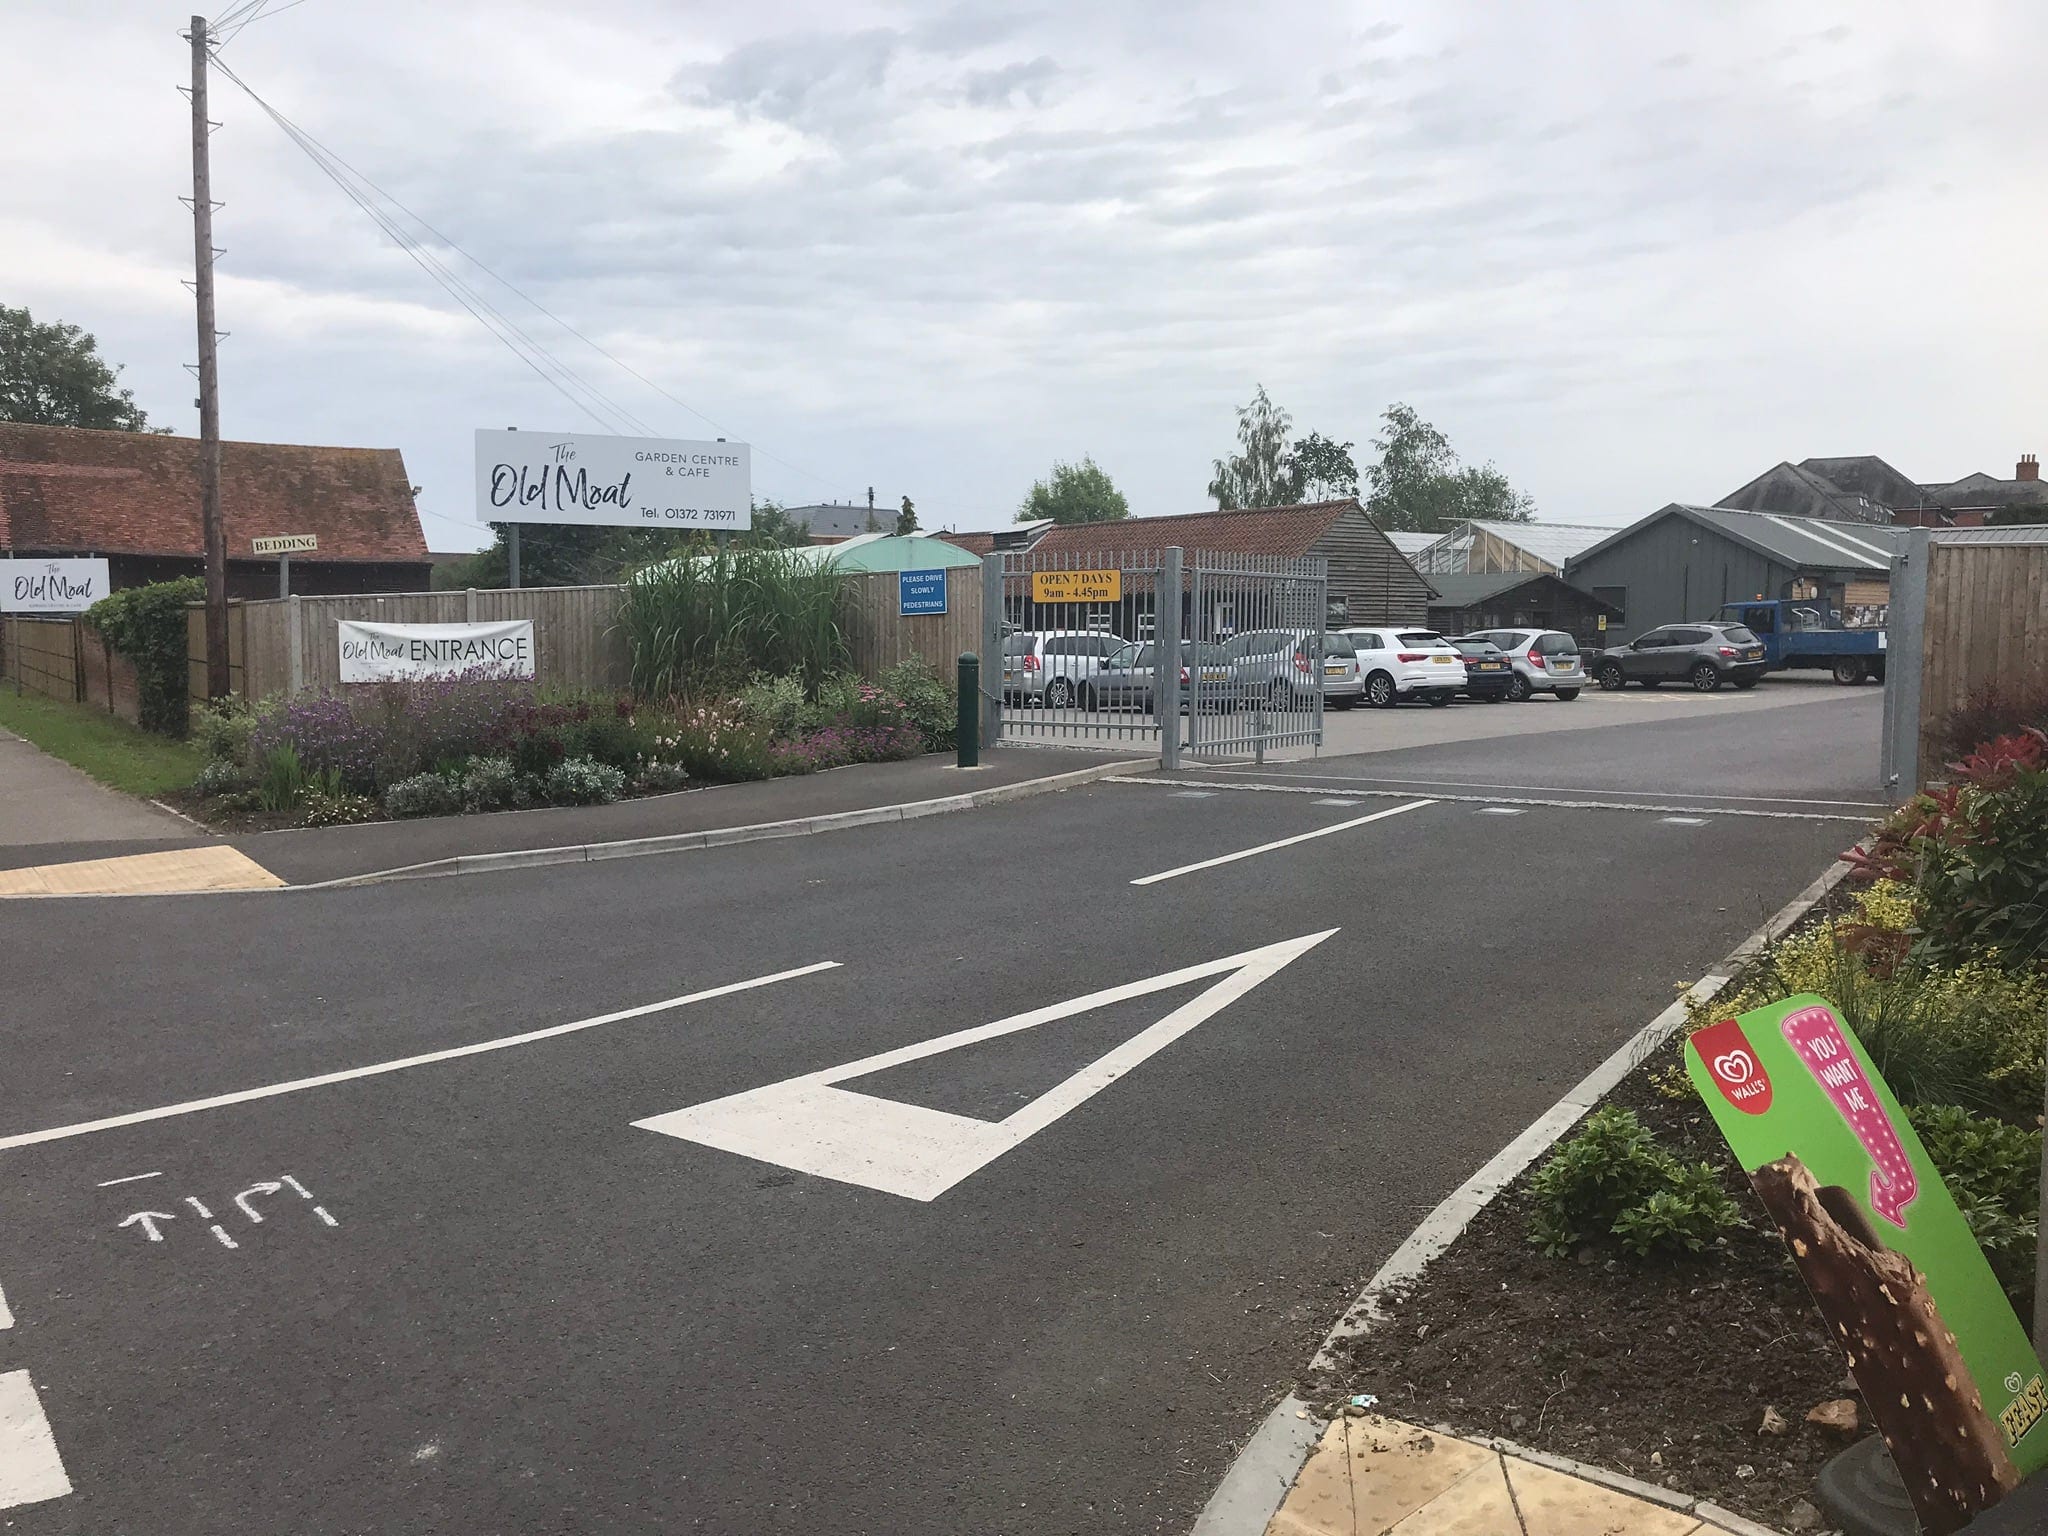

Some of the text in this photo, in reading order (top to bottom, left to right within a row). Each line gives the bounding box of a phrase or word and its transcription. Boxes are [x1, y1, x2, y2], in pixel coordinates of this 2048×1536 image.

[549, 442, 576, 463] The
[635, 451, 740, 466] GARDEN CENTRE
[665, 466, 710, 478] & CAFE
[491, 464, 632, 511] Old Moat
[665, 508, 698, 520] 01372
[703, 509, 736, 521] 731971
[255, 537, 316, 551] BEDDING
[902, 574, 943, 583] PLEASE DRIVE
[1040, 572, 1113, 585] OPEN 7 DAYS
[14, 576, 46, 601] Old
[910, 586, 935, 595] SLOWLY
[1044, 588, 1064, 598] 9am
[1073, 586, 1108, 600] 4.45pm
[903, 600, 944, 609] PEDESTRIANS
[343, 641, 368, 660] Old
[410, 638, 527, 661] ENTRANCE
[1806, 1034, 1838, 1062] YOU
[1819, 1058, 1859, 1089] WANT
[1731, 1079, 1766, 1101] WALL'S
[1843, 1087, 1869, 1113] ME
[1999, 1374, 2048, 1448] FEAST
